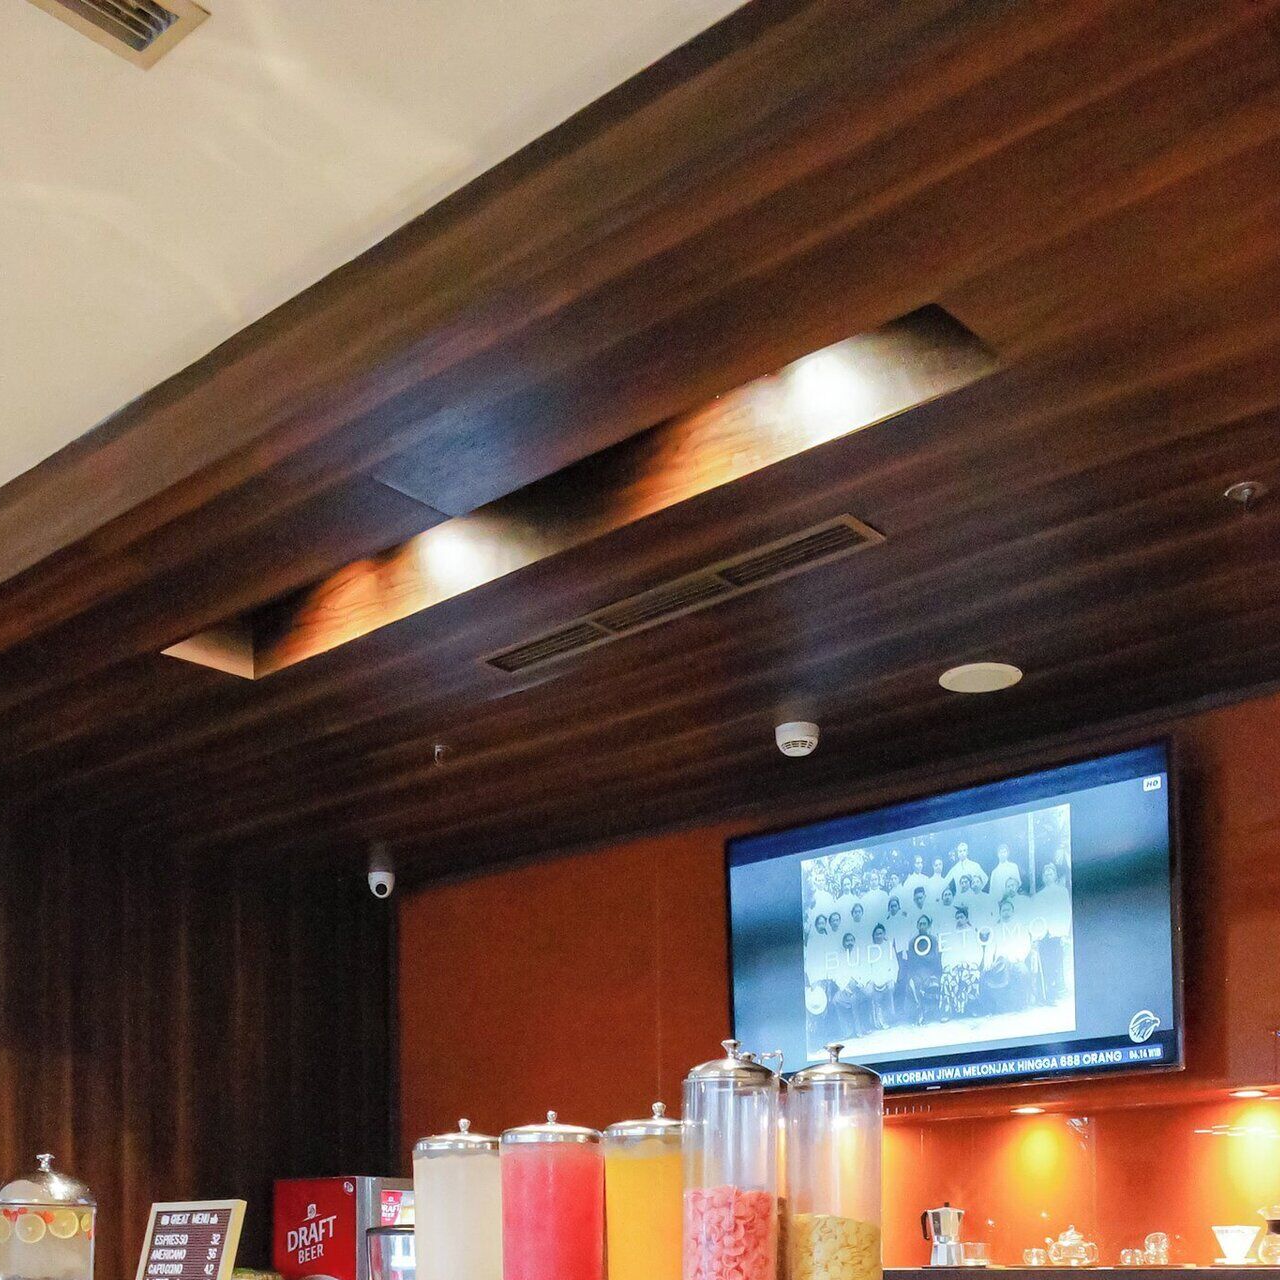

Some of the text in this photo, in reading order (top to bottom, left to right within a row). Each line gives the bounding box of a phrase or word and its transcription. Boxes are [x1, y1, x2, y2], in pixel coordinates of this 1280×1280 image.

[896, 1071, 935, 1084] KORBAN
[936, 1068, 961, 1081] JIWA
[963, 1062, 1016, 1078] MELONJAK
[1017, 1057, 1058, 1072] HINGGA
[1082, 1050, 1123, 1064] ORANG
[154, 1233, 189, 1246] ESPRESSO
[286, 1215, 337, 1253] DRAFT
[150, 1248, 187, 1261] AMERICANO
[298, 1243, 324, 1264] BEER
[203, 1263, 215, 1276] 42
